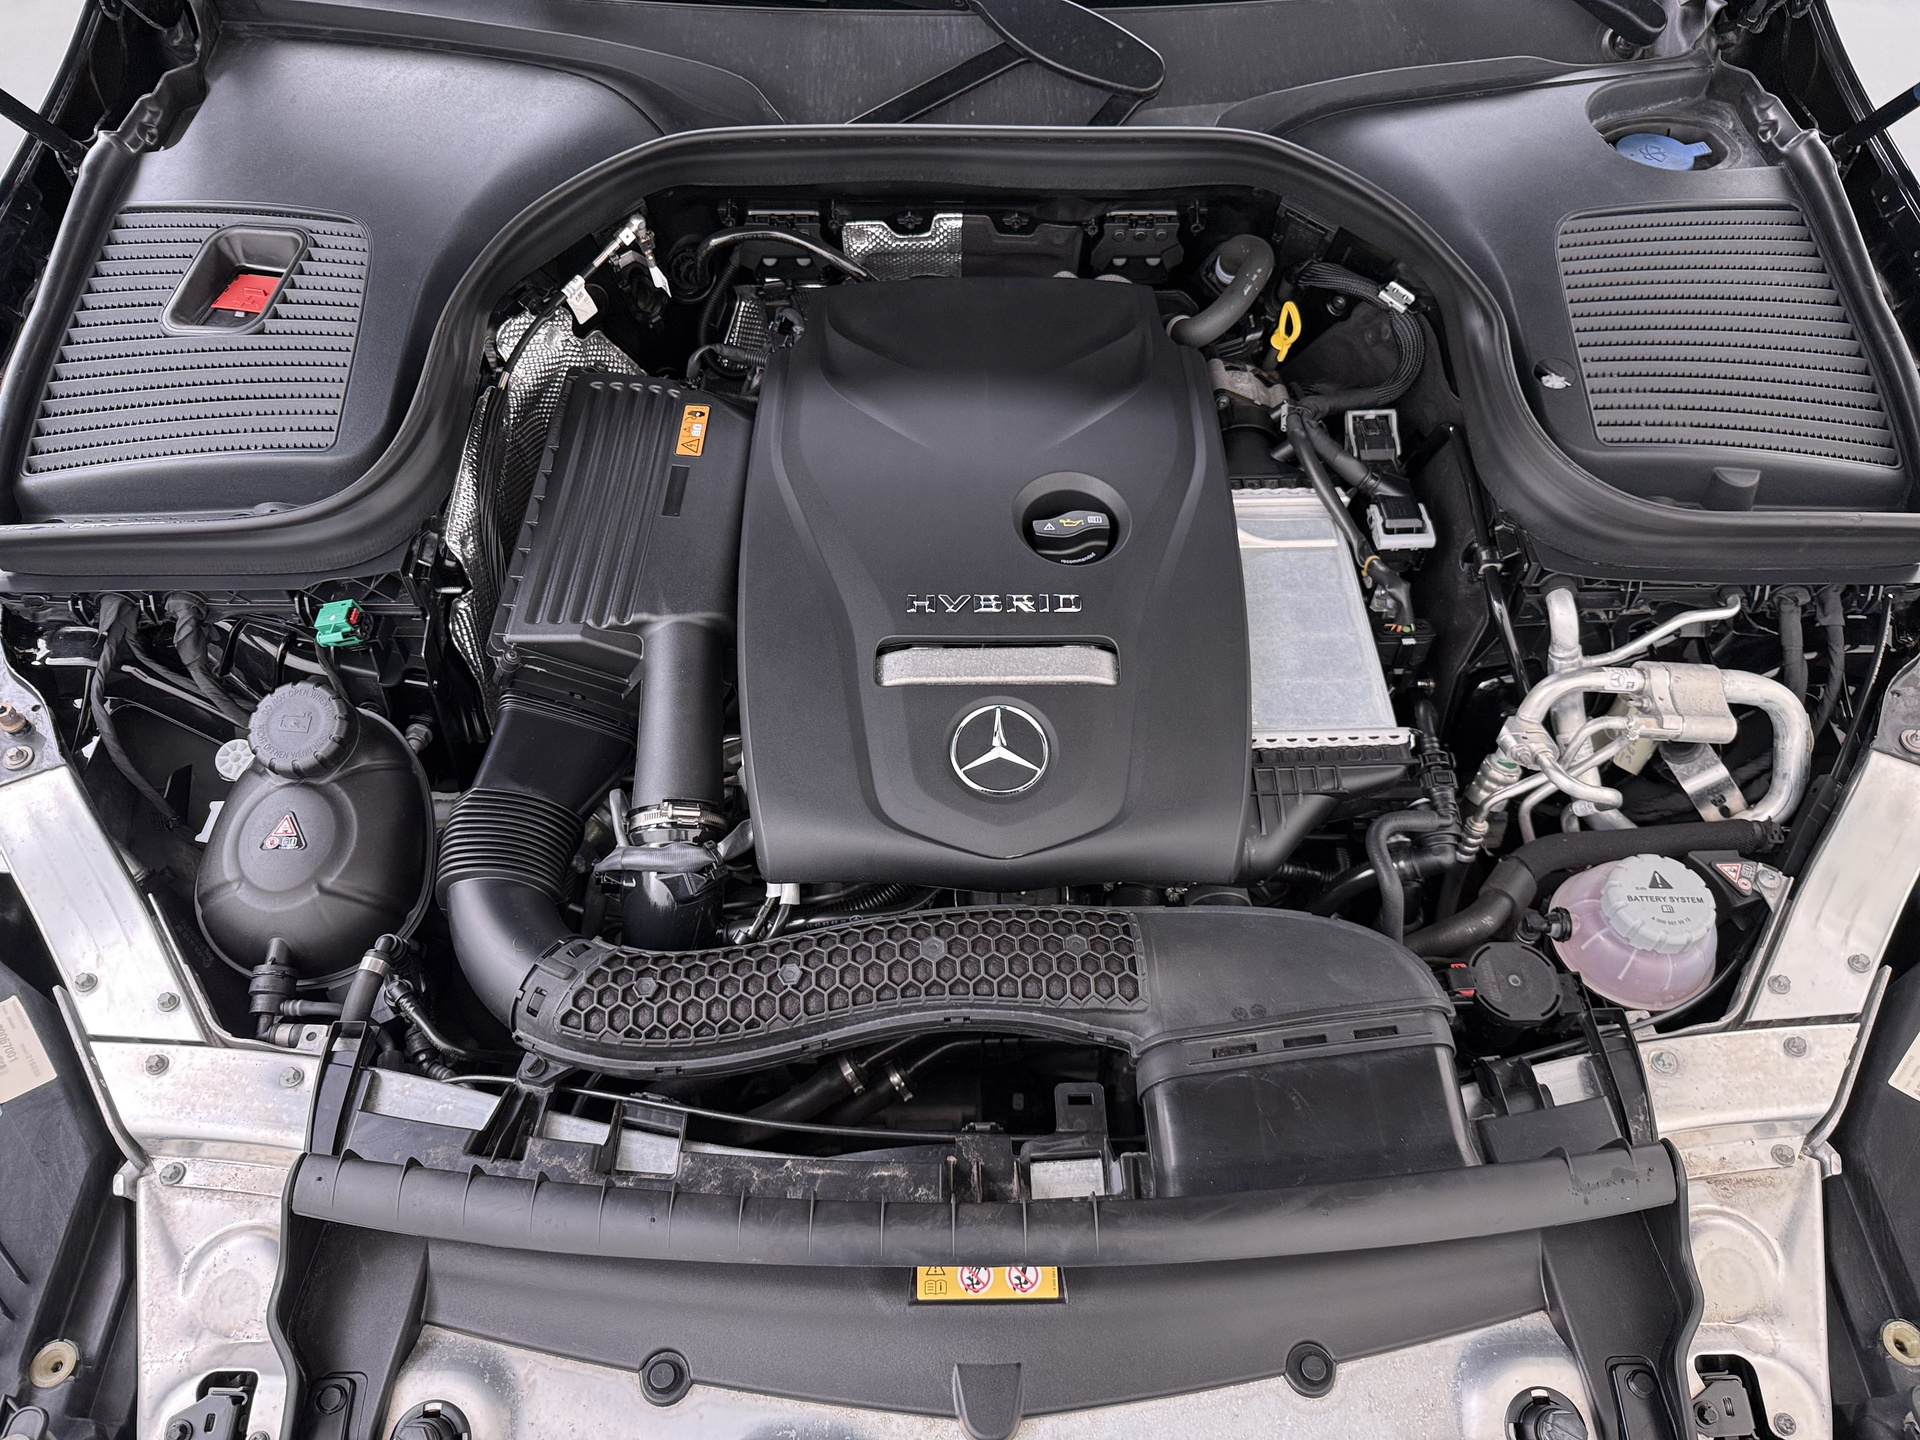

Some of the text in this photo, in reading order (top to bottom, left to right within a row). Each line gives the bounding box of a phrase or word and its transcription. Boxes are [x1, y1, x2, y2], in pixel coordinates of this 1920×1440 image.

[906, 594, 1082, 613] HYBRID
[261, 705, 272, 715] DO
[273, 693, 286, 705] NOT
[288, 688, 310, 698] OPEN
[311, 691, 329, 707] WHEN
[290, 747, 312, 758] WENN
